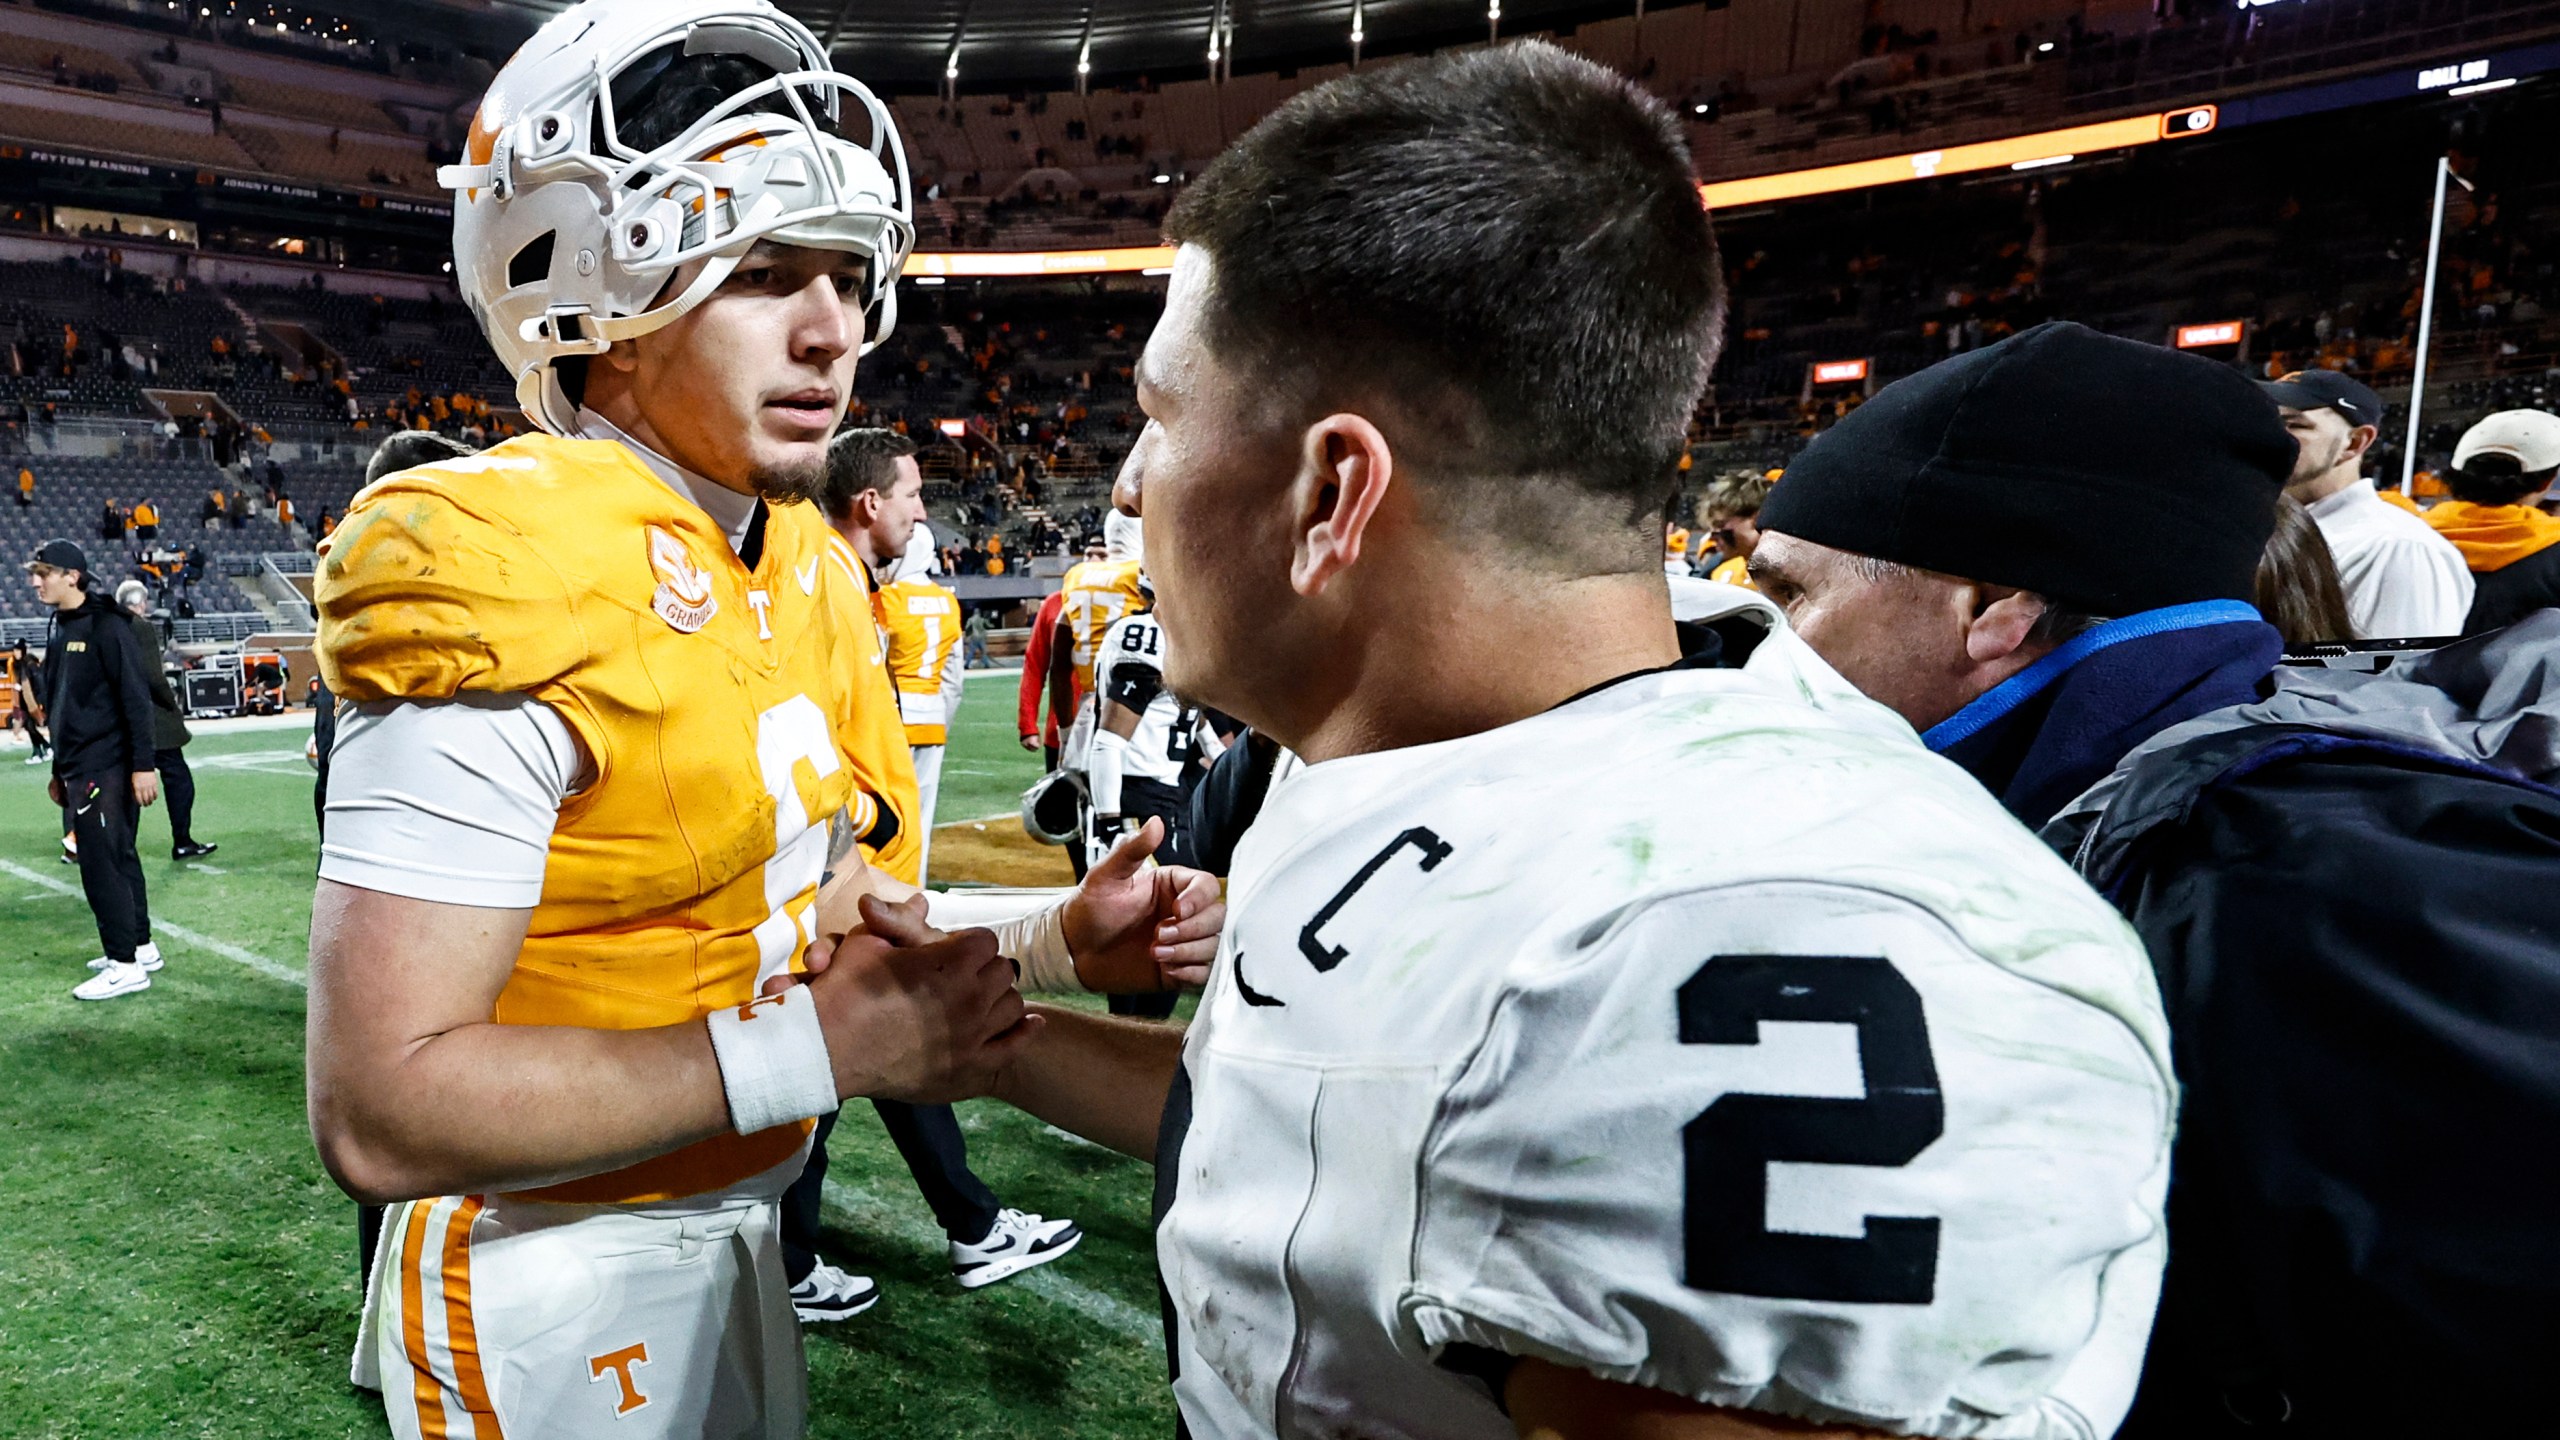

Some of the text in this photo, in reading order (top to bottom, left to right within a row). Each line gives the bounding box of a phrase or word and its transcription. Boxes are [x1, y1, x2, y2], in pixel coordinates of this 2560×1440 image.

[31, 151, 85, 166] PEYTON
[89, 159, 149, 176] MANNING
[747, 590, 772, 640] T
[1121, 624, 1158, 656] 81
[918, 617, 940, 678] 1
[1299, 826, 1454, 973] C
[1677, 954, 1944, 1305] 2
[585, 1340, 653, 1418] T
